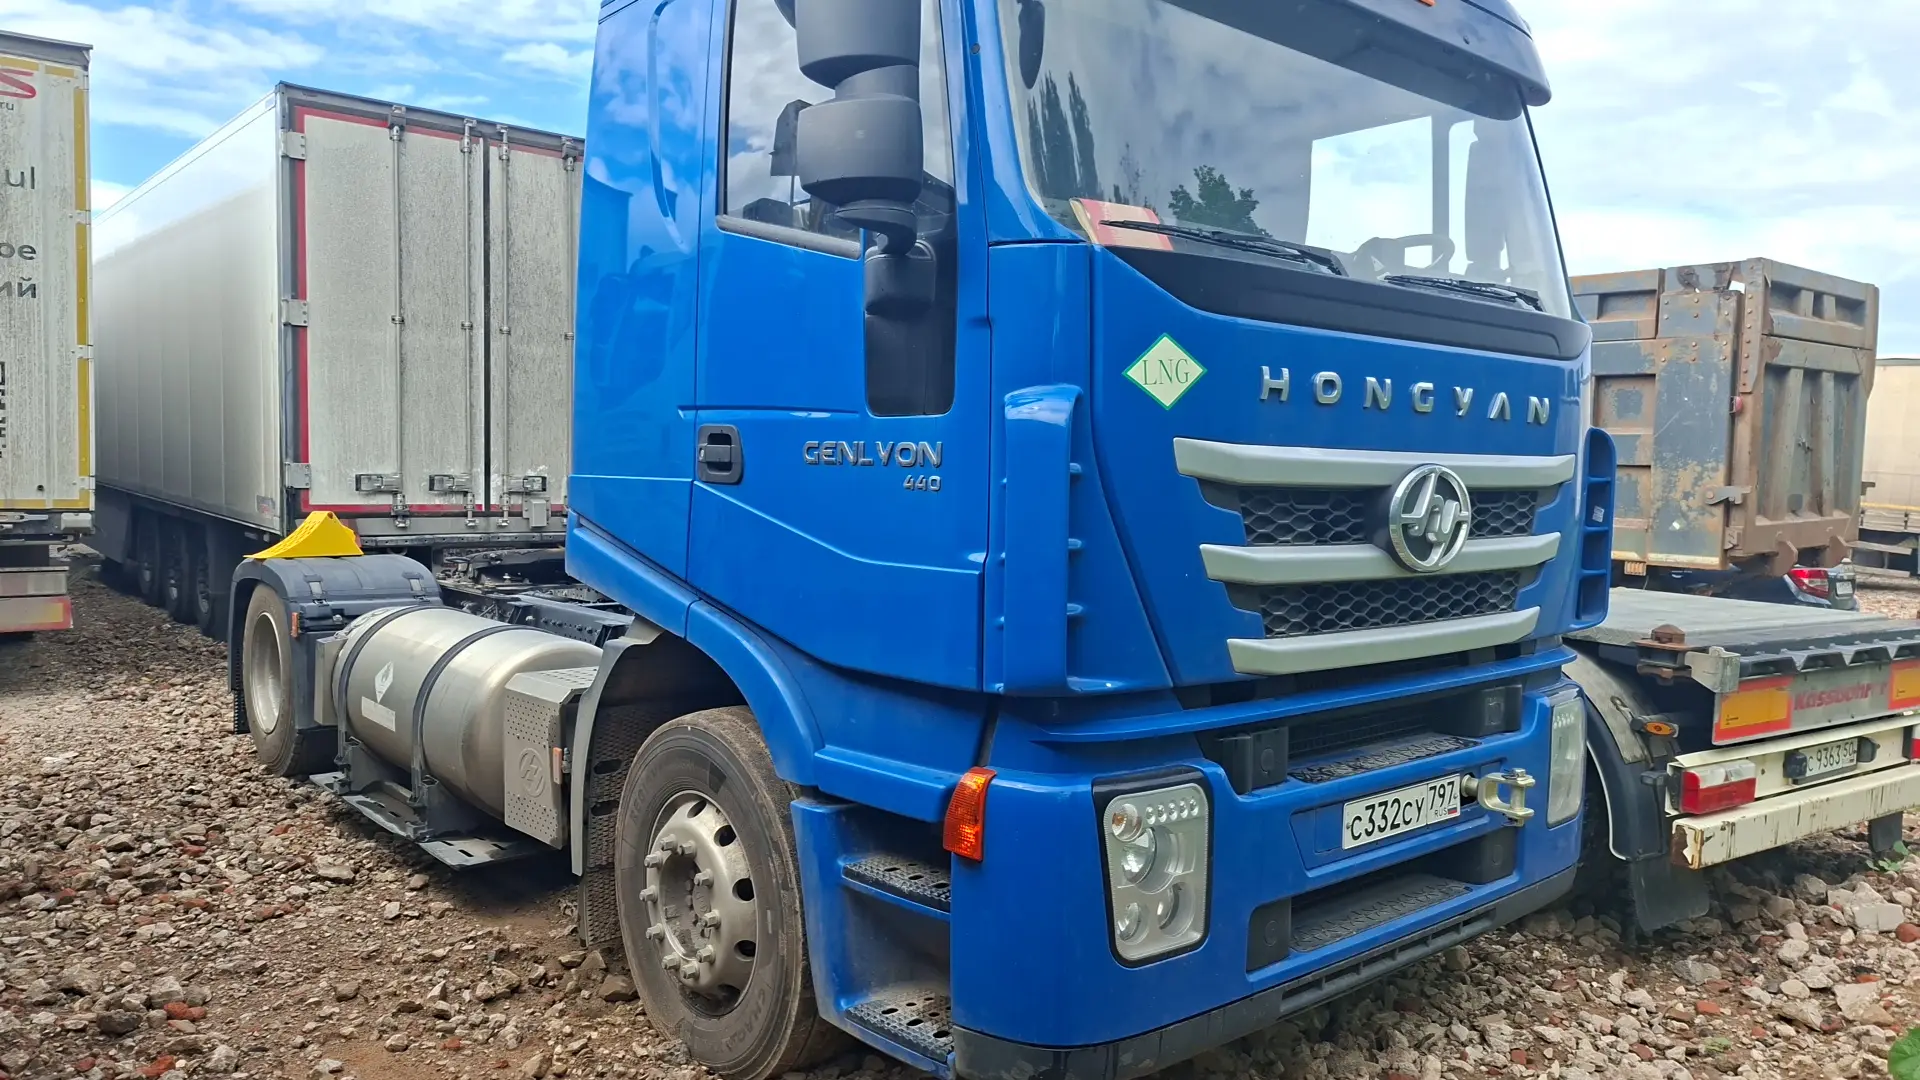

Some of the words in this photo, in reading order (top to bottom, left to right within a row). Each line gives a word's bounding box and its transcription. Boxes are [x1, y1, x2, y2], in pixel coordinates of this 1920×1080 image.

[1142, 358, 1190, 386] LNG
[1259, 365, 1551, 426] HONGYAN
[803, 440, 944, 468] GENLYON
[903, 474, 942, 492] 440
[1816, 744, 1842, 771] 9363
[1428, 780, 1456, 811] 797
[1434, 807, 1448, 818] RUS
